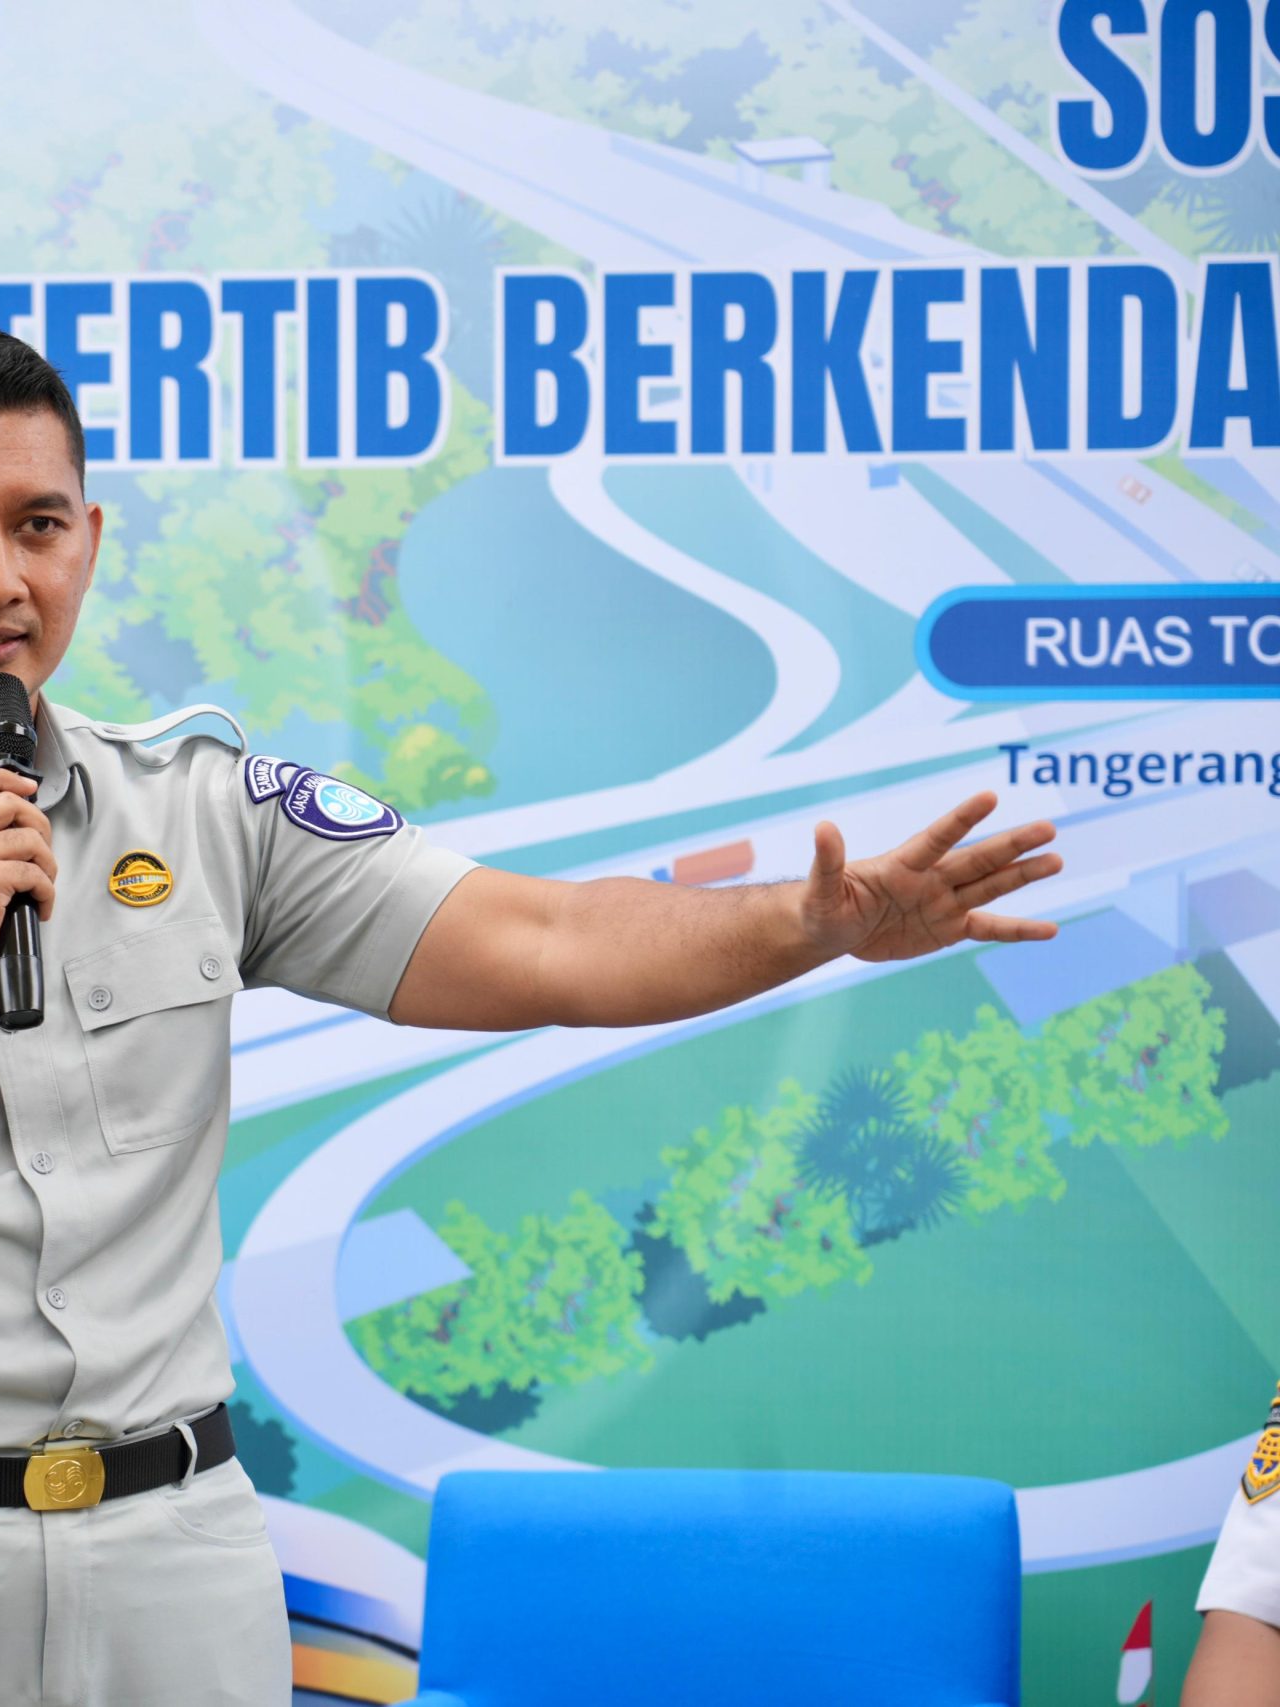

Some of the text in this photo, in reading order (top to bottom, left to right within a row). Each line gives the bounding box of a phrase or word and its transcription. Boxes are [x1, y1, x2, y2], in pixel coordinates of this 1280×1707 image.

[1057, 0, 1280, 171] SO
[502, 261, 1280, 458] BERKENDA
[1025, 615, 1280, 667] RUAS TO
[291, 789, 313, 814] JASA
